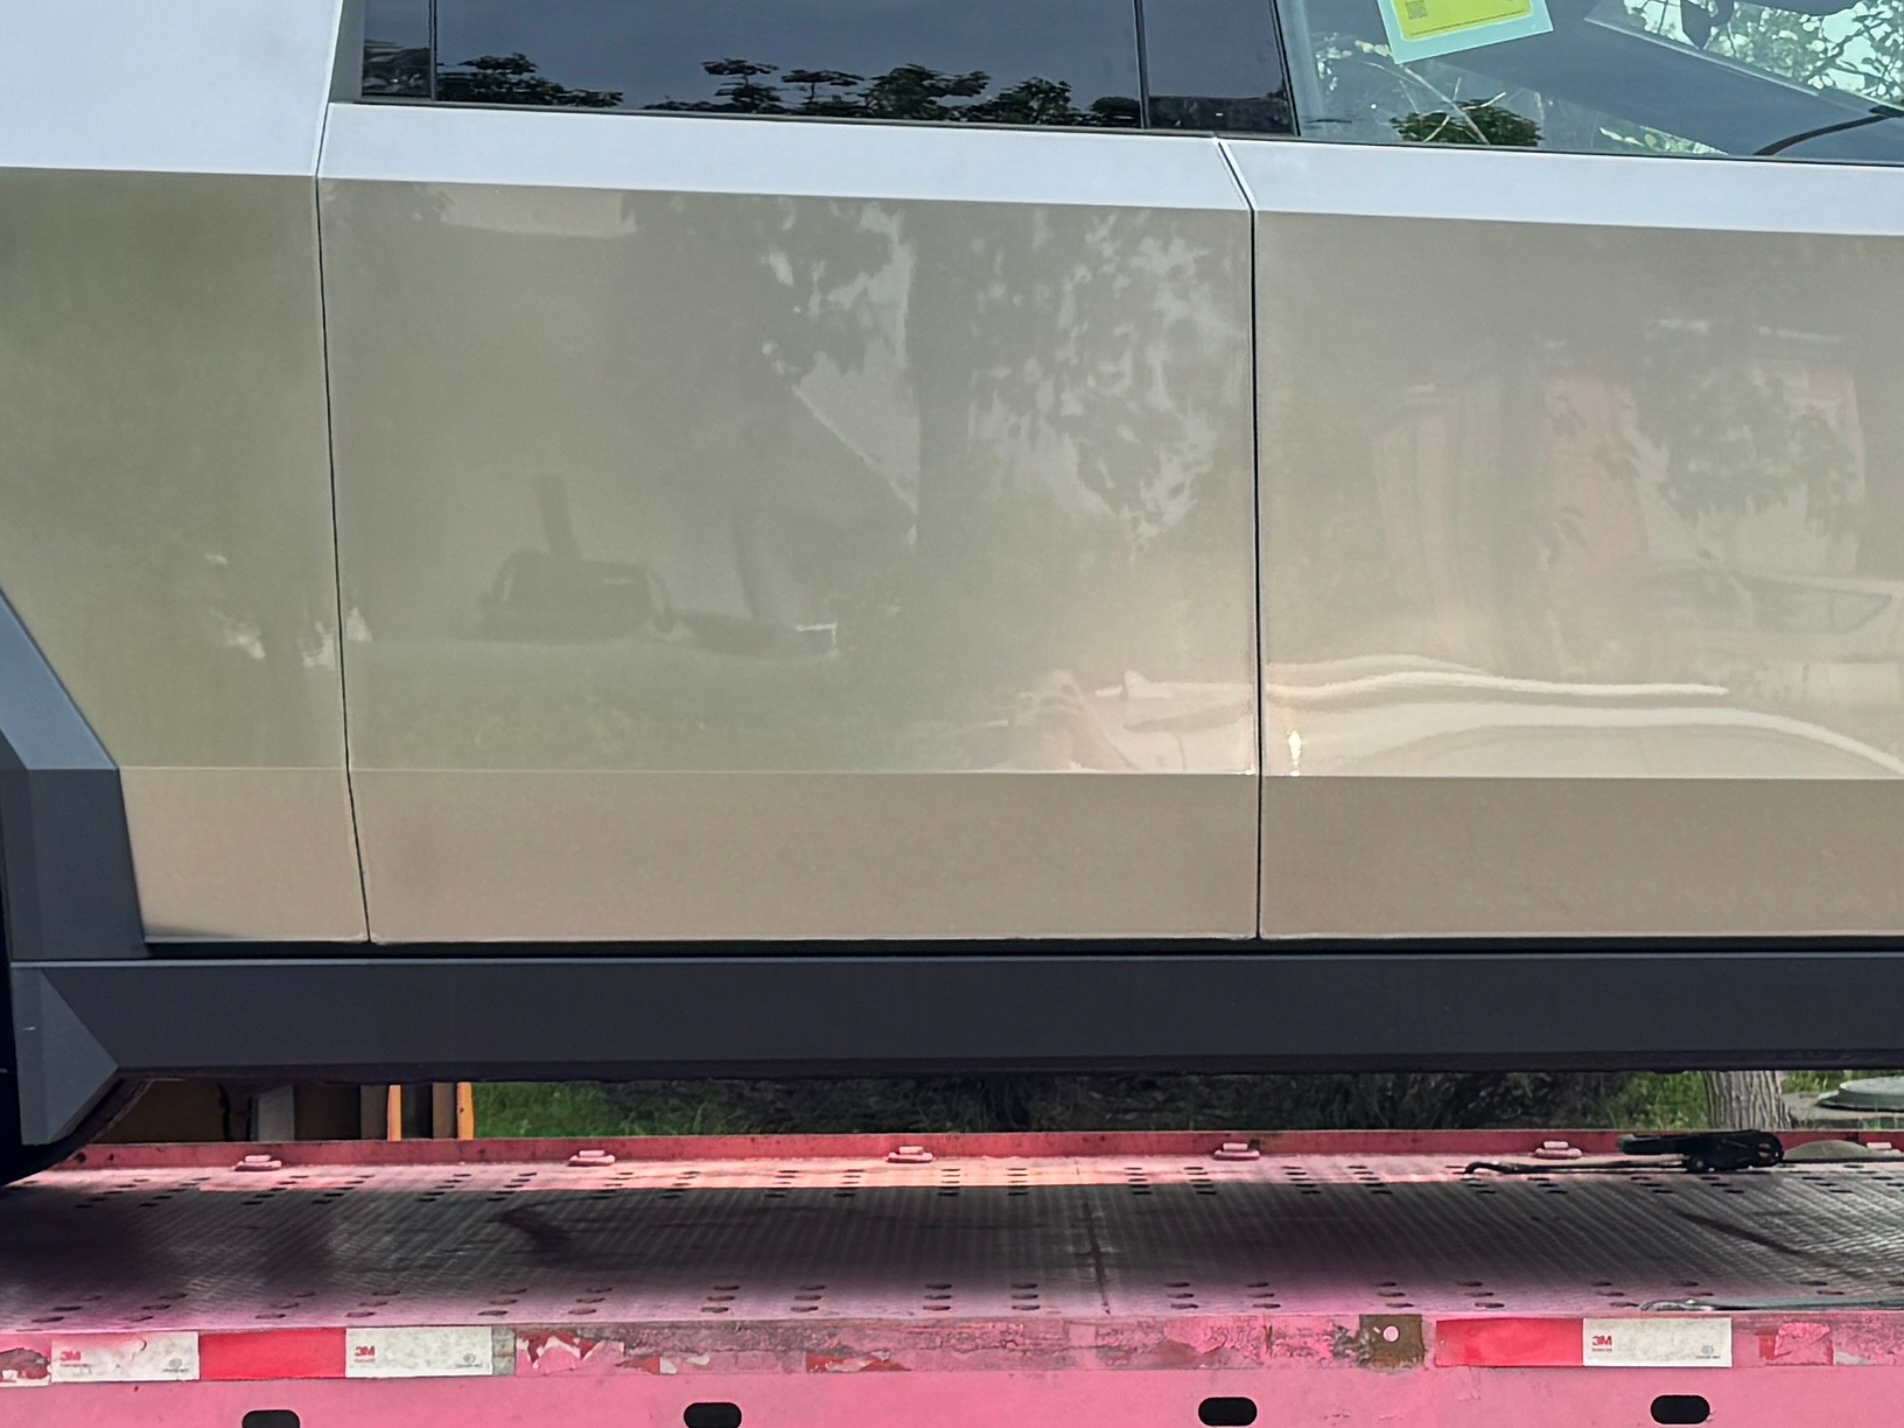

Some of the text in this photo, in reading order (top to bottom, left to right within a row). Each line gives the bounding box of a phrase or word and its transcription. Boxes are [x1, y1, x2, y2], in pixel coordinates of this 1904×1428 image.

[1592, 1335, 1612, 1346] 3M
[60, 1351, 81, 1361] 3M
[355, 1346, 375, 1357] 3M
